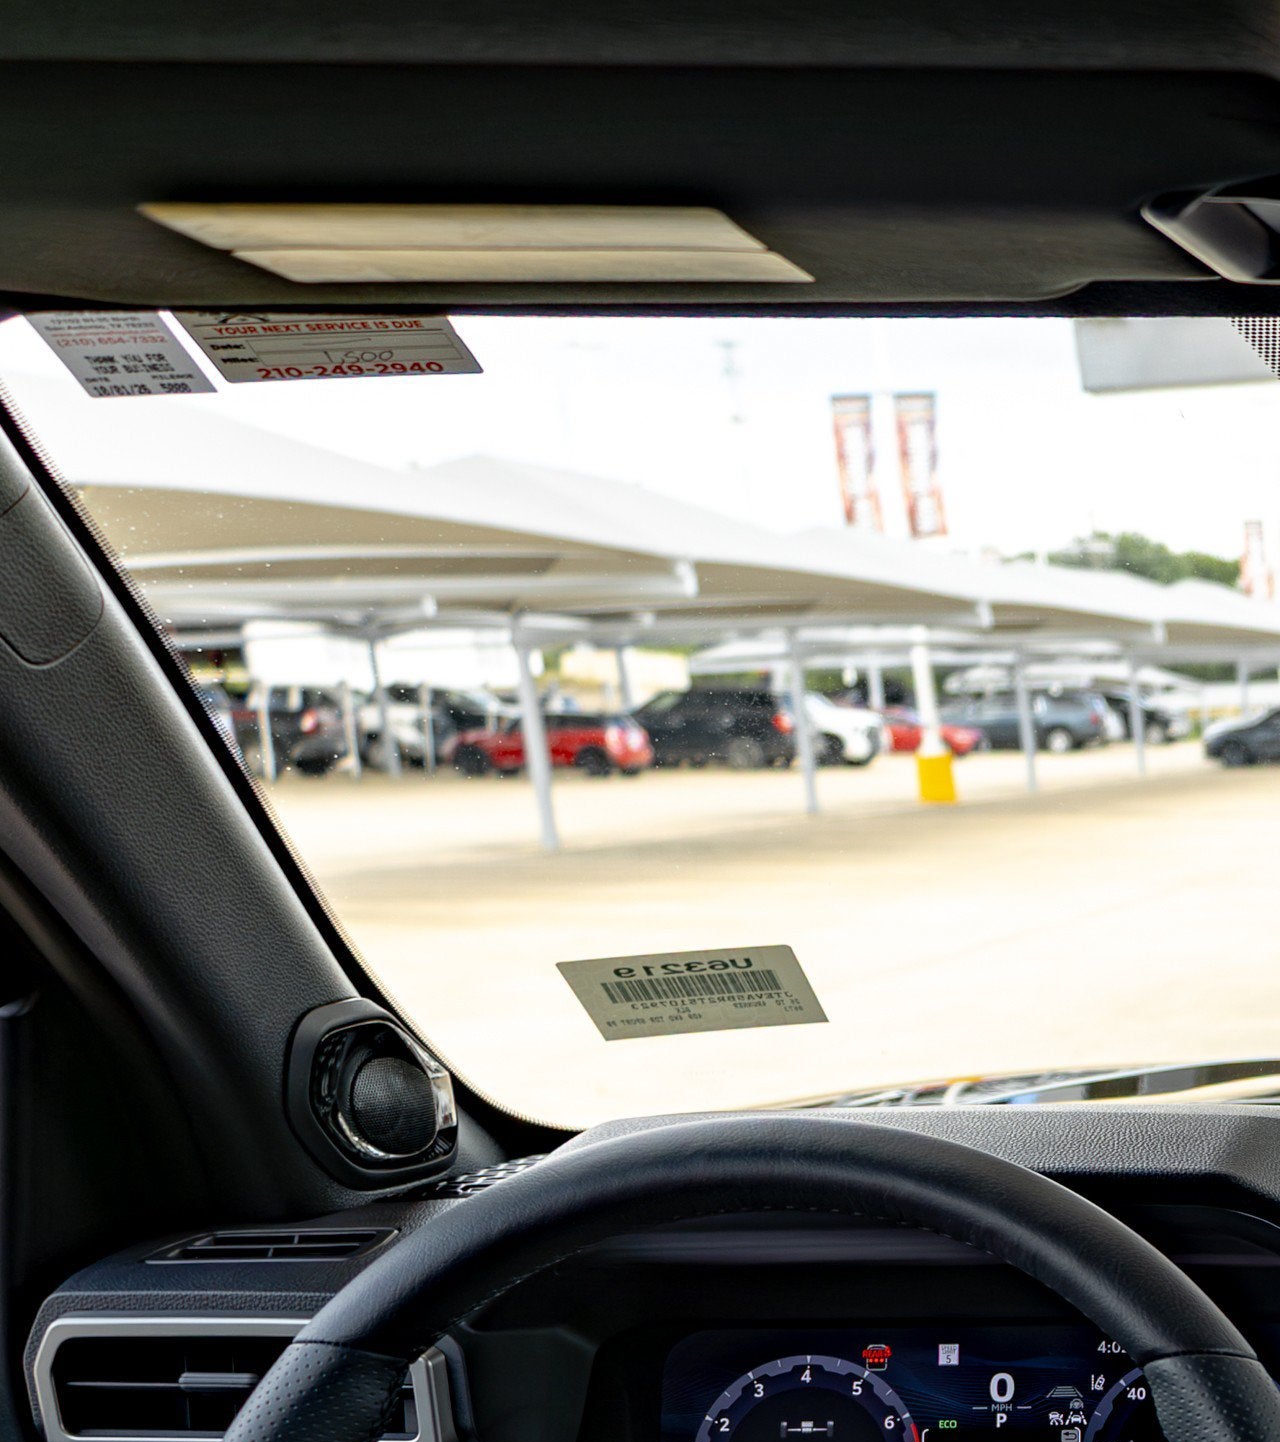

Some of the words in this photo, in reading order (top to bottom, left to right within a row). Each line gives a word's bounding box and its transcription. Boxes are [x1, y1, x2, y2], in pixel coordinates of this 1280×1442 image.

[214, 326, 259, 336] YOUR
[263, 324, 301, 334] NEXT
[305, 322, 372, 332] SERVICE
[375, 321, 389, 330] IS
[392, 320, 425, 329] DUE
[256, 361, 444, 380] 210-249-2940
[801, 1370, 811, 1383] 4
[754, 1384, 764, 1397] 3
[852, 1382, 862, 1395] 5
[989, 1372, 1015, 1403] 0
[1128, 1388, 1146, 1400] 40
[991, 1404, 1013, 1412] MPH
[720, 1419, 730, 1432] 2
[885, 1416, 895, 1429] 6
[938, 1420, 957, 1429] ECO
[996, 1414, 1007, 1428] P
